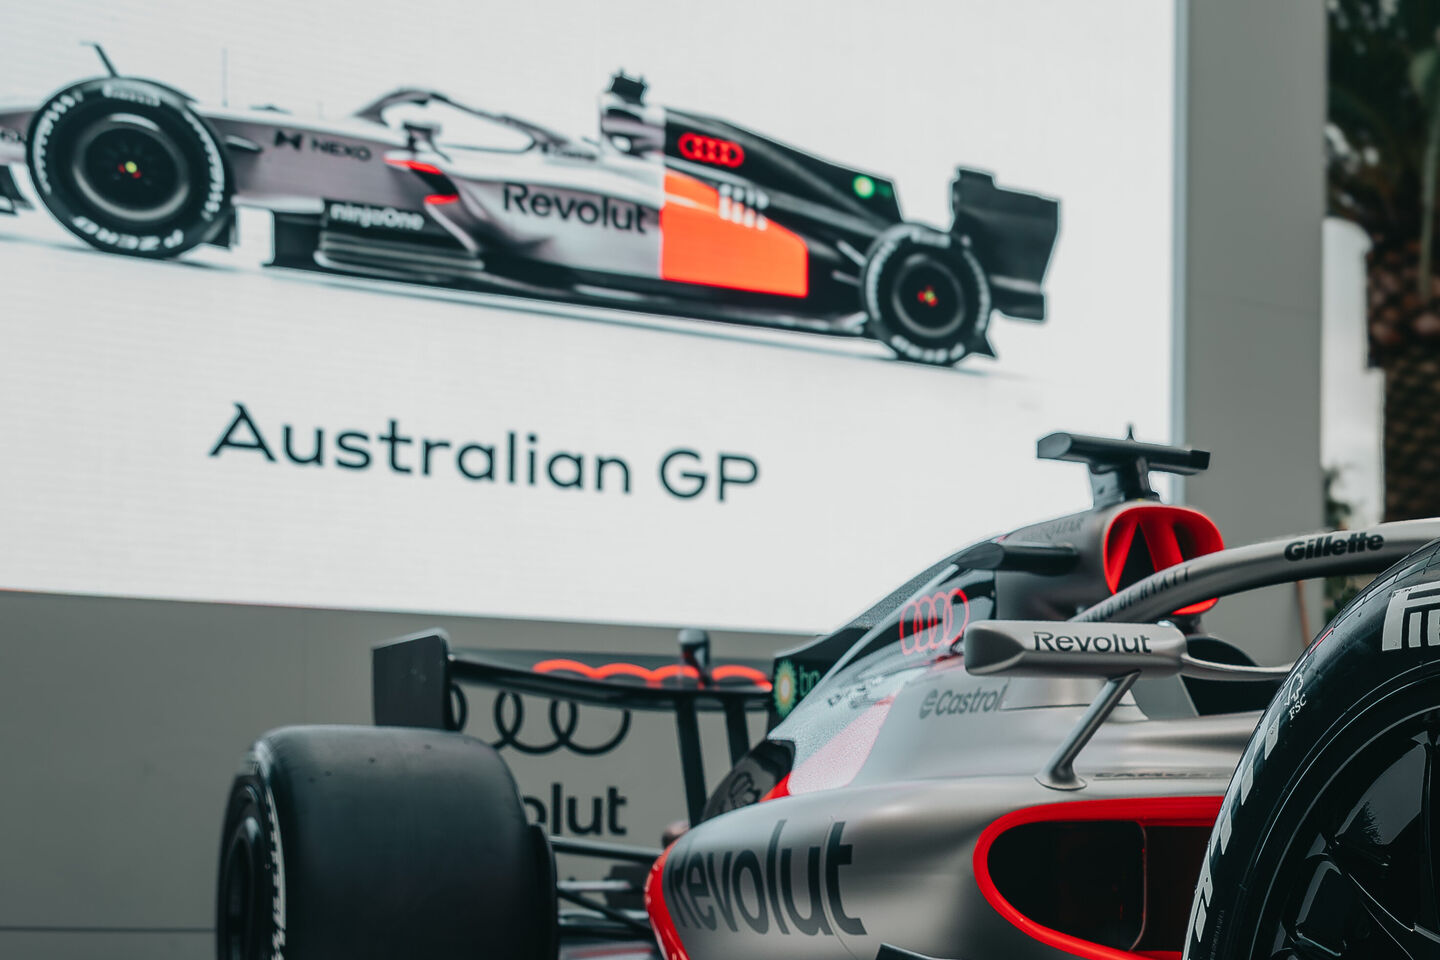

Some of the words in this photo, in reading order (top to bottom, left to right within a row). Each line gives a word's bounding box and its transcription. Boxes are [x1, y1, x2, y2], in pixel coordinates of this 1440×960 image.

[502, 182, 648, 235] Revolut
[208, 402, 633, 494] Australian
[659, 447, 759, 501] GP
[1284, 531, 1384, 562] Gillette
[1033, 631, 1152, 655] Revolut
[935, 685, 1008, 717] Castrol
[1288, 694, 1309, 721] FSC
